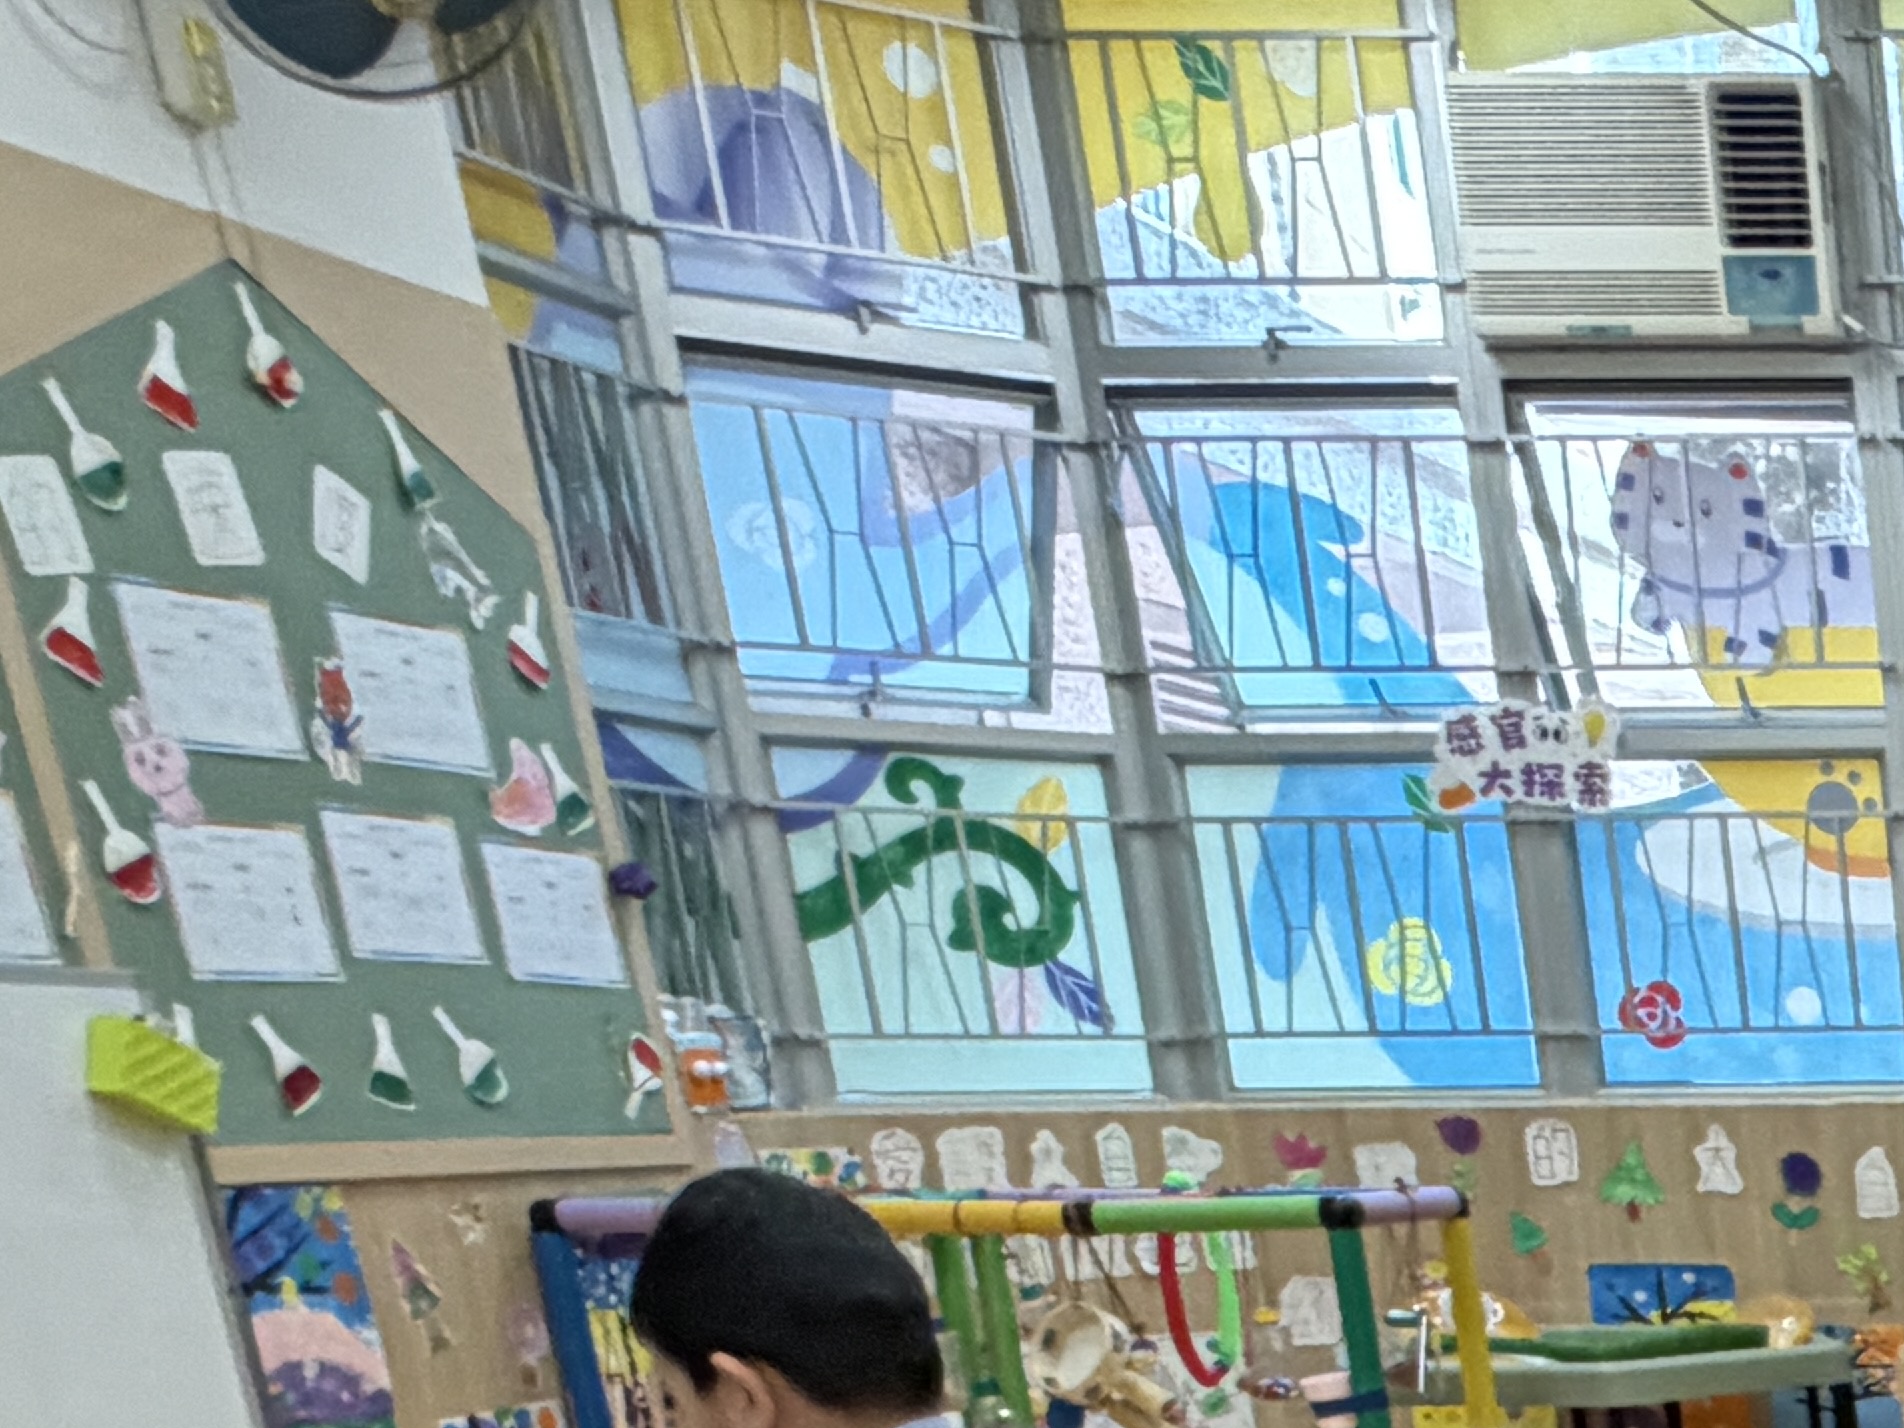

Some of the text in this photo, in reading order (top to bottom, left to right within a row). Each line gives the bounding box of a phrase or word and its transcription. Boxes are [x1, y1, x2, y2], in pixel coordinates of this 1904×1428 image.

[1446, 707, 1528, 757] 感官
[1478, 760, 1611, 807] 大探索
